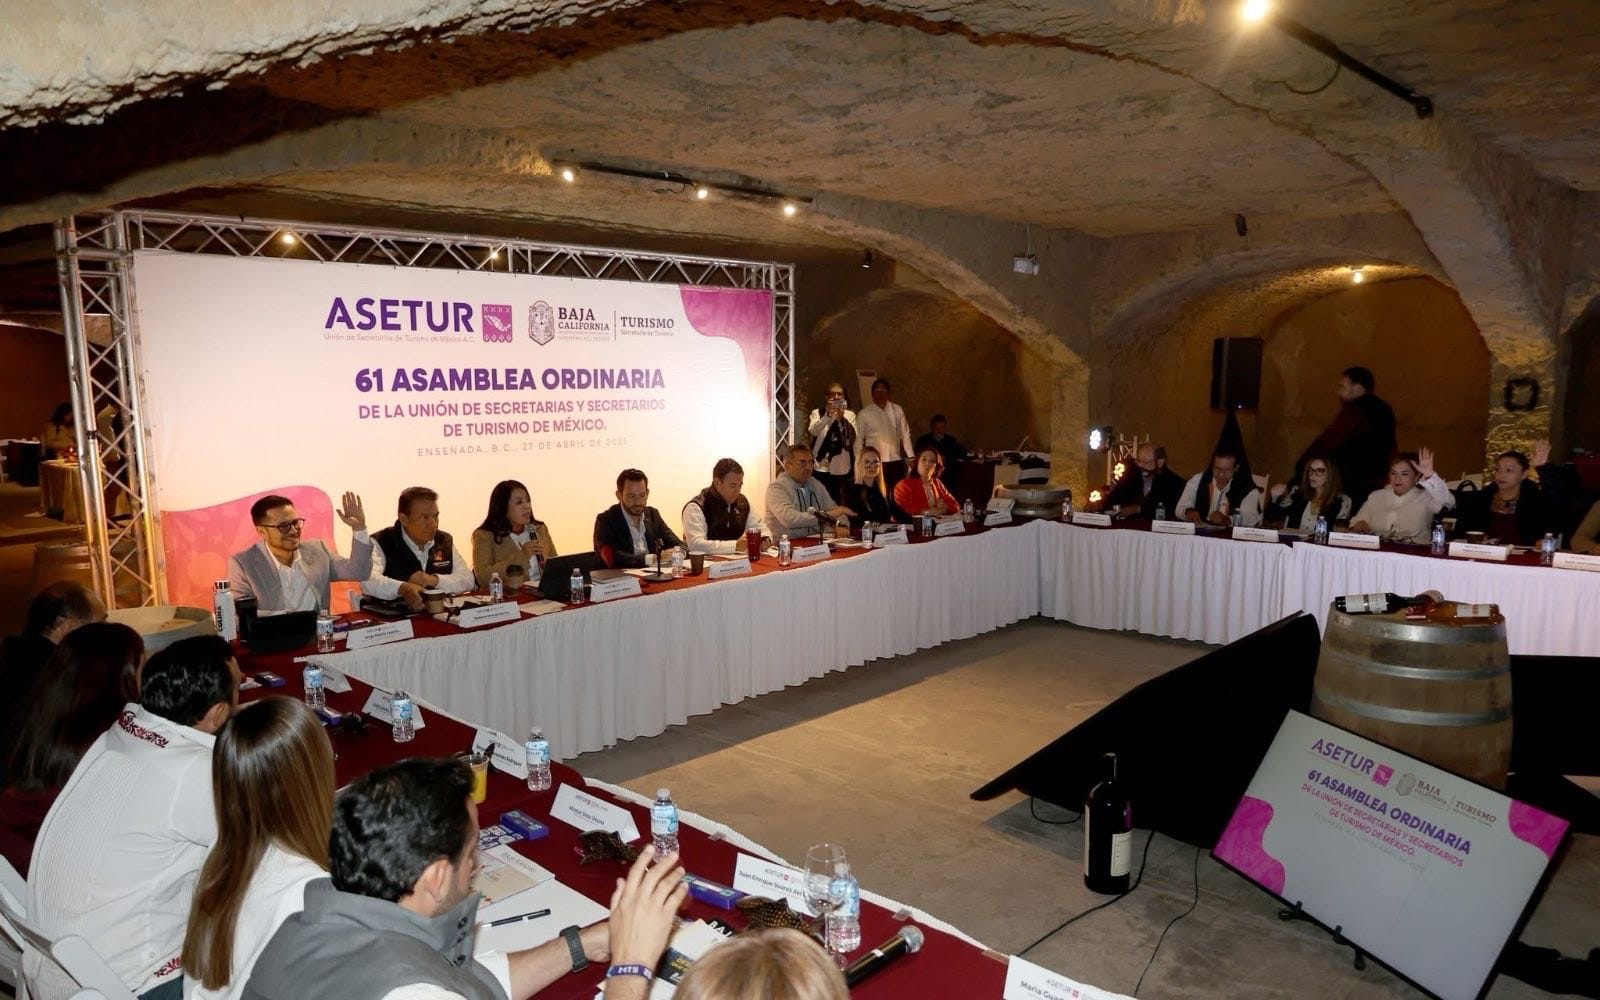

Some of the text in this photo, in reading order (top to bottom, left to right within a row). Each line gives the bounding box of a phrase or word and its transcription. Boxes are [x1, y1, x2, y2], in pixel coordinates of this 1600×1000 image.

[325, 297, 474, 333] ASETUR
[558, 307, 595, 321] BAJA
[620, 317, 675, 329] TURISMO
[558, 321, 610, 331] CALIFORNIA
[355, 368, 665, 393] 61 ASAMBLEA ORDINARIA
[359, 399, 666, 419] DE LA UNIÓN DE SECRETARIAS Y SECRETARIOS
[443, 417, 607, 437] DE TURISMO DE MÉXICO.
[521, 442, 534, 451] 27
[538, 441, 551, 450] DE
[556, 439, 585, 449] ABRIL
[590, 438, 601, 447] DE
[1311, 738, 1375, 775] ASETUR
[1417, 780, 1441, 796] BAJA
[1308, 770, 1471, 854] 61 ASAMBLEA ORDINARIA
[1455, 801, 1497, 823] TURISMO
[1302, 783, 1312, 793] DE
[1311, 788, 1320, 796] LA
[1343, 803, 1354, 813] DE
[1408, 835, 1464, 867] SECRETARIOS
[1329, 808, 1340, 818] DE
[1340, 813, 1372, 834] TURISMO
[1371, 829, 1383, 839] DE
[739, 870, 751, 878] Juan
